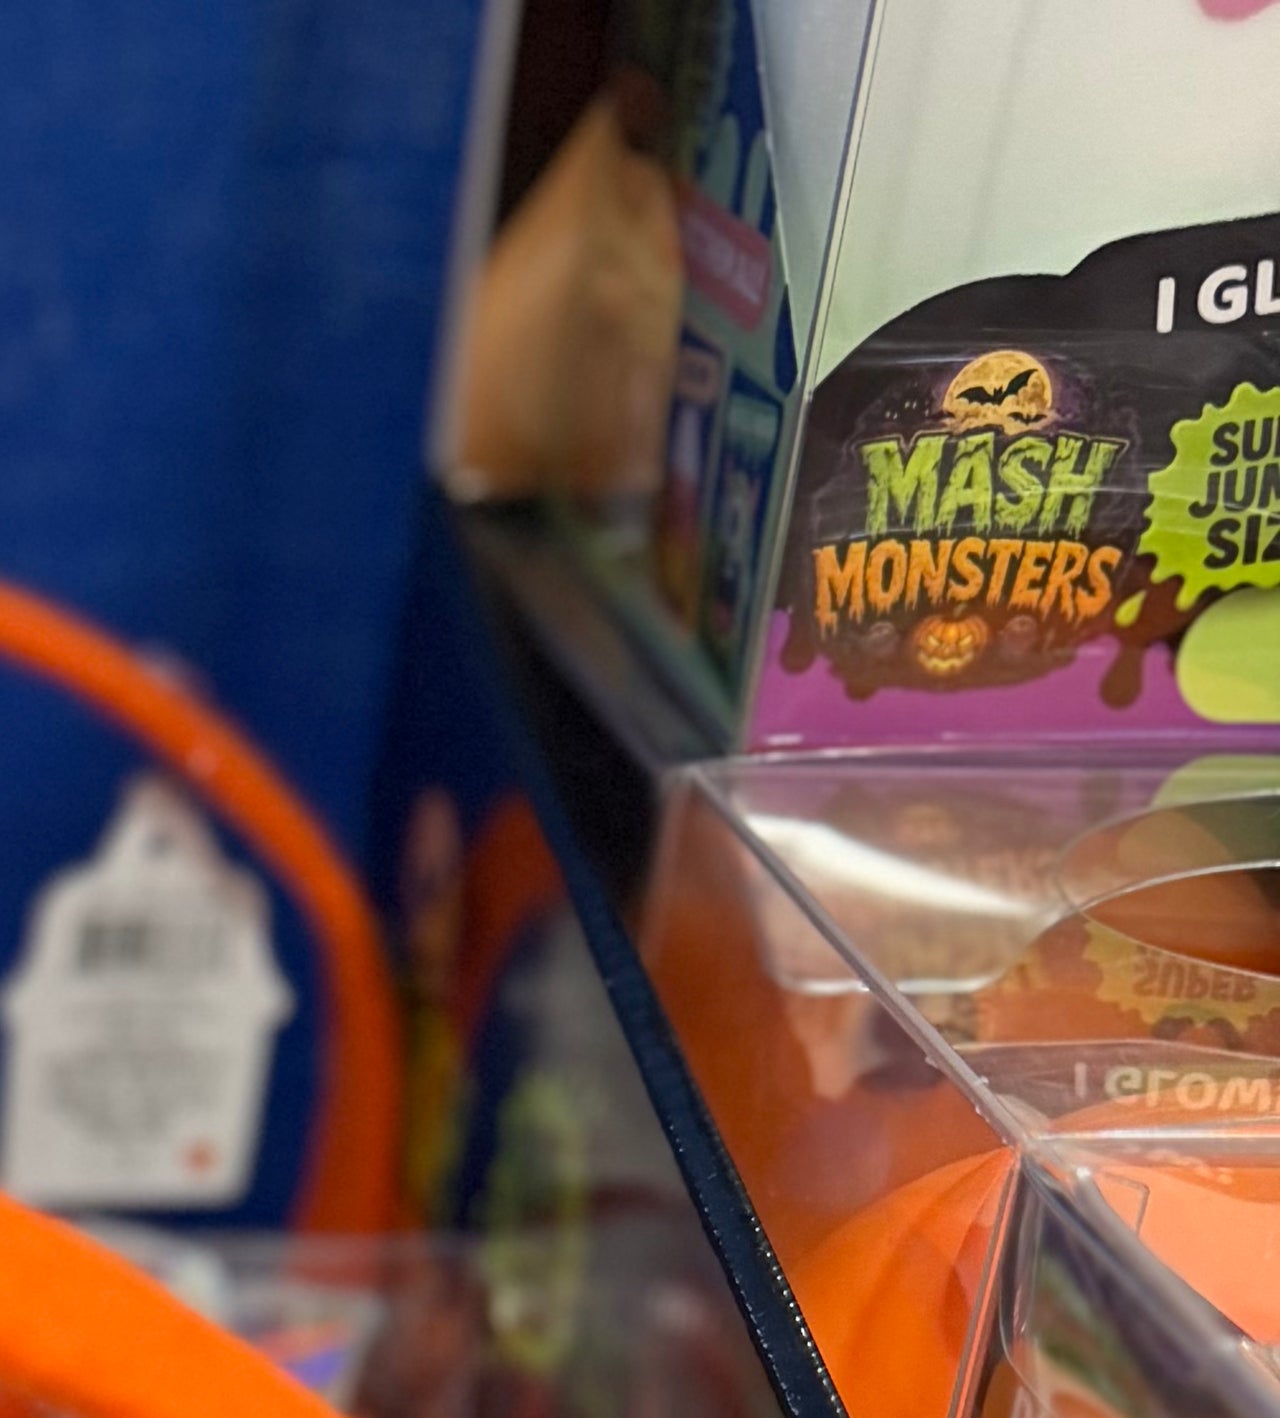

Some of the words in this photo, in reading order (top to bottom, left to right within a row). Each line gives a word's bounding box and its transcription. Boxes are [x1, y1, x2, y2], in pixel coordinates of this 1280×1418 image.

[1156, 277, 1175, 333] I
[1209, 416, 1280, 466] SU
[859, 430, 1128, 538] MASH
[813, 539, 1124, 635] MONSTERS
